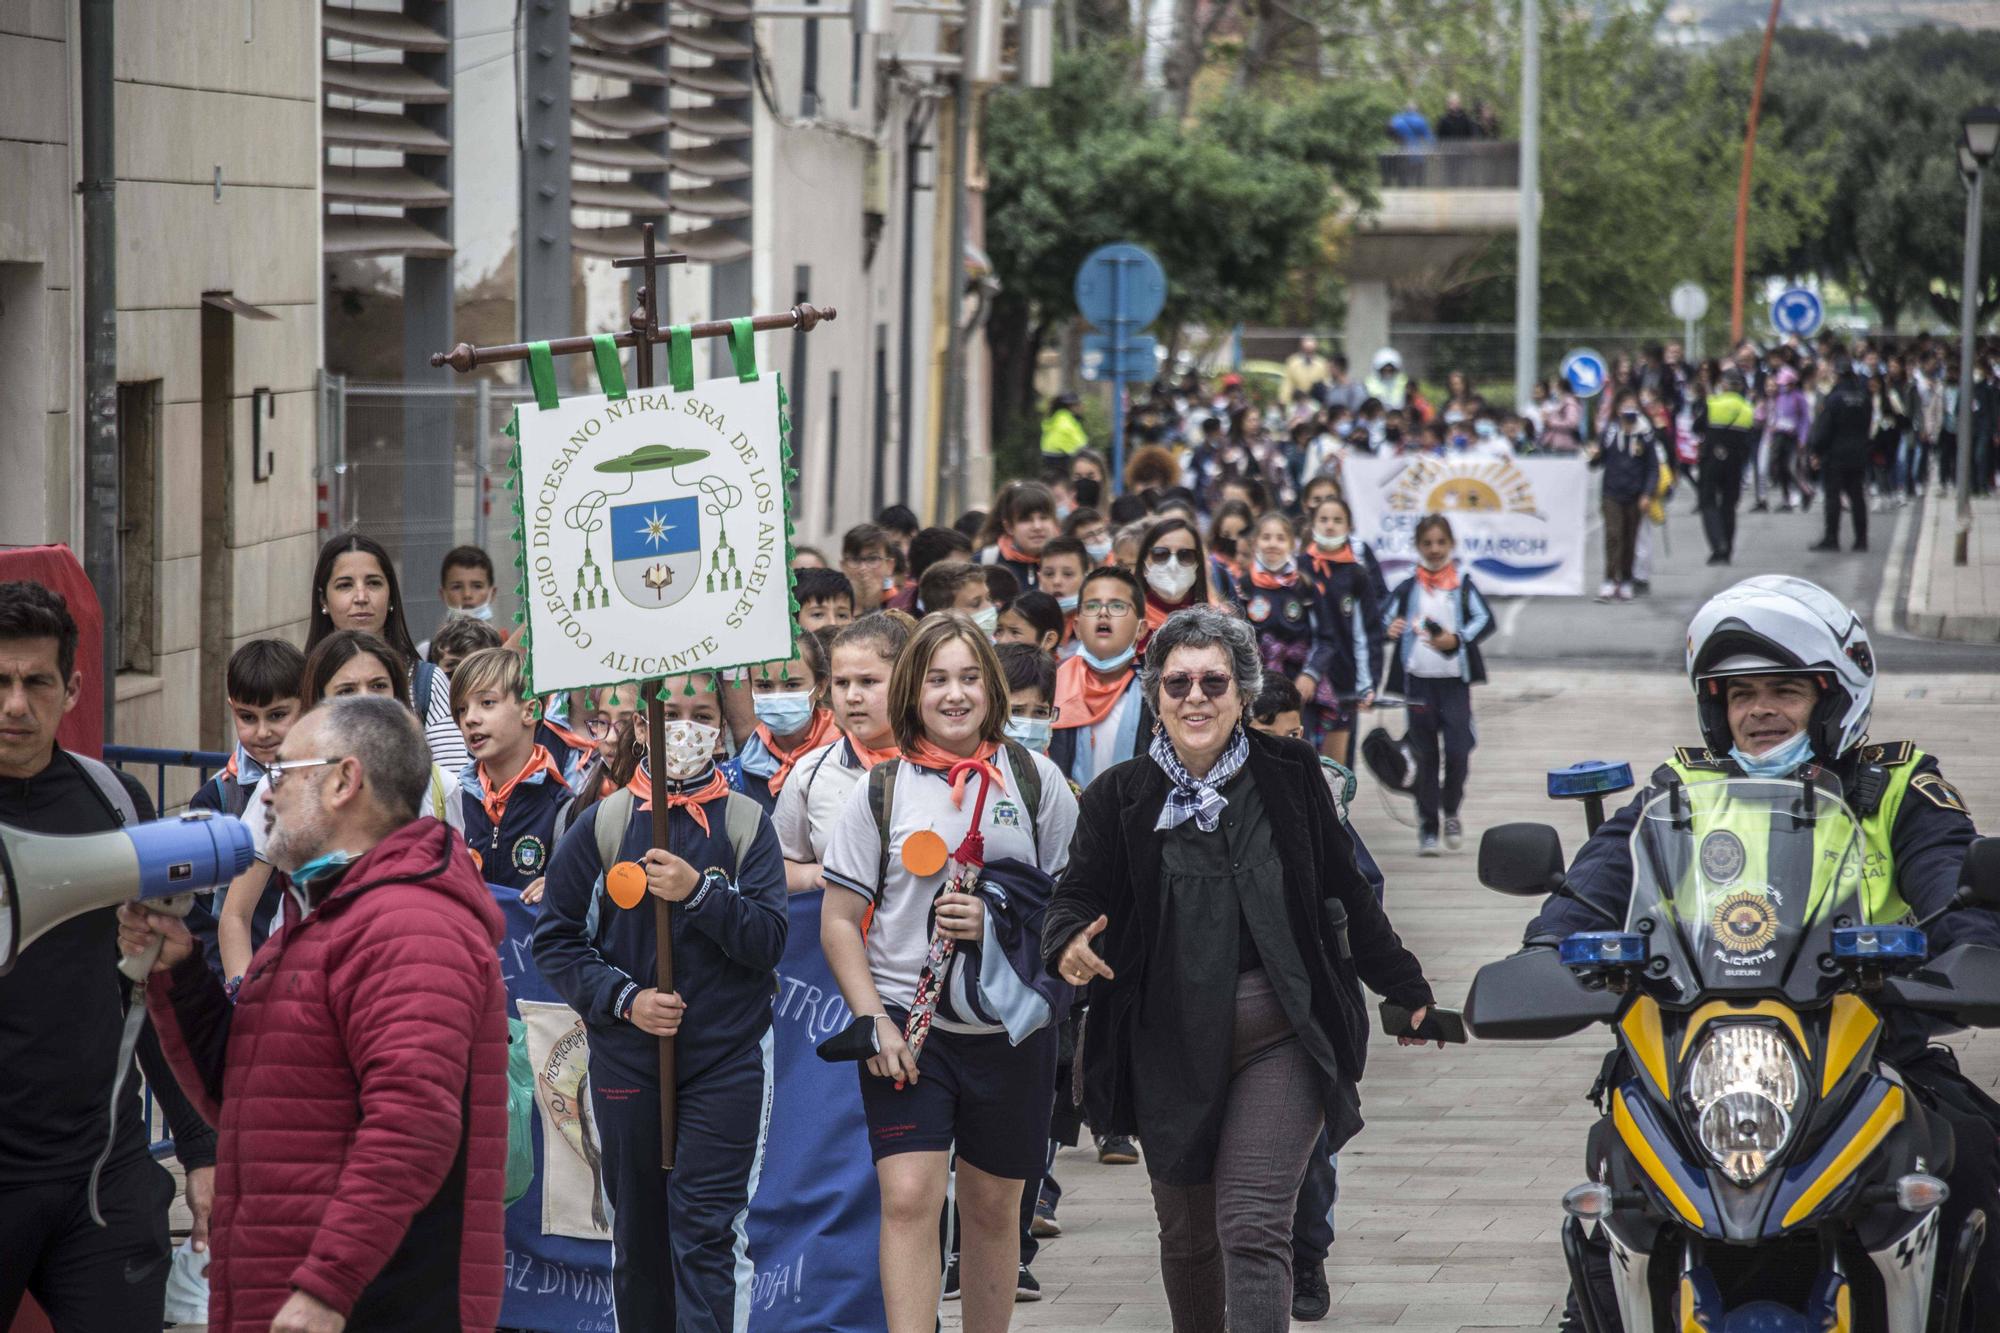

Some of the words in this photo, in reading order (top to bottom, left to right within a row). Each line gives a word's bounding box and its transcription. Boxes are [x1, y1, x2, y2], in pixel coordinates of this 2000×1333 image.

[604, 394, 675, 424] NTRA.
[684, 398, 726, 436] SRA.
[730, 432, 759, 465] DE
[534, 418, 602, 548] DIOCESANO
[750, 468, 774, 515] LOS
[725, 521, 775, 630] ANGELES
[534, 556, 592, 650] COLEGIO
[600, 635, 720, 675] ALICANTE
[1713, 949, 1776, 966] ALICANTE
[1724, 969, 1761, 977] SUZUKI
